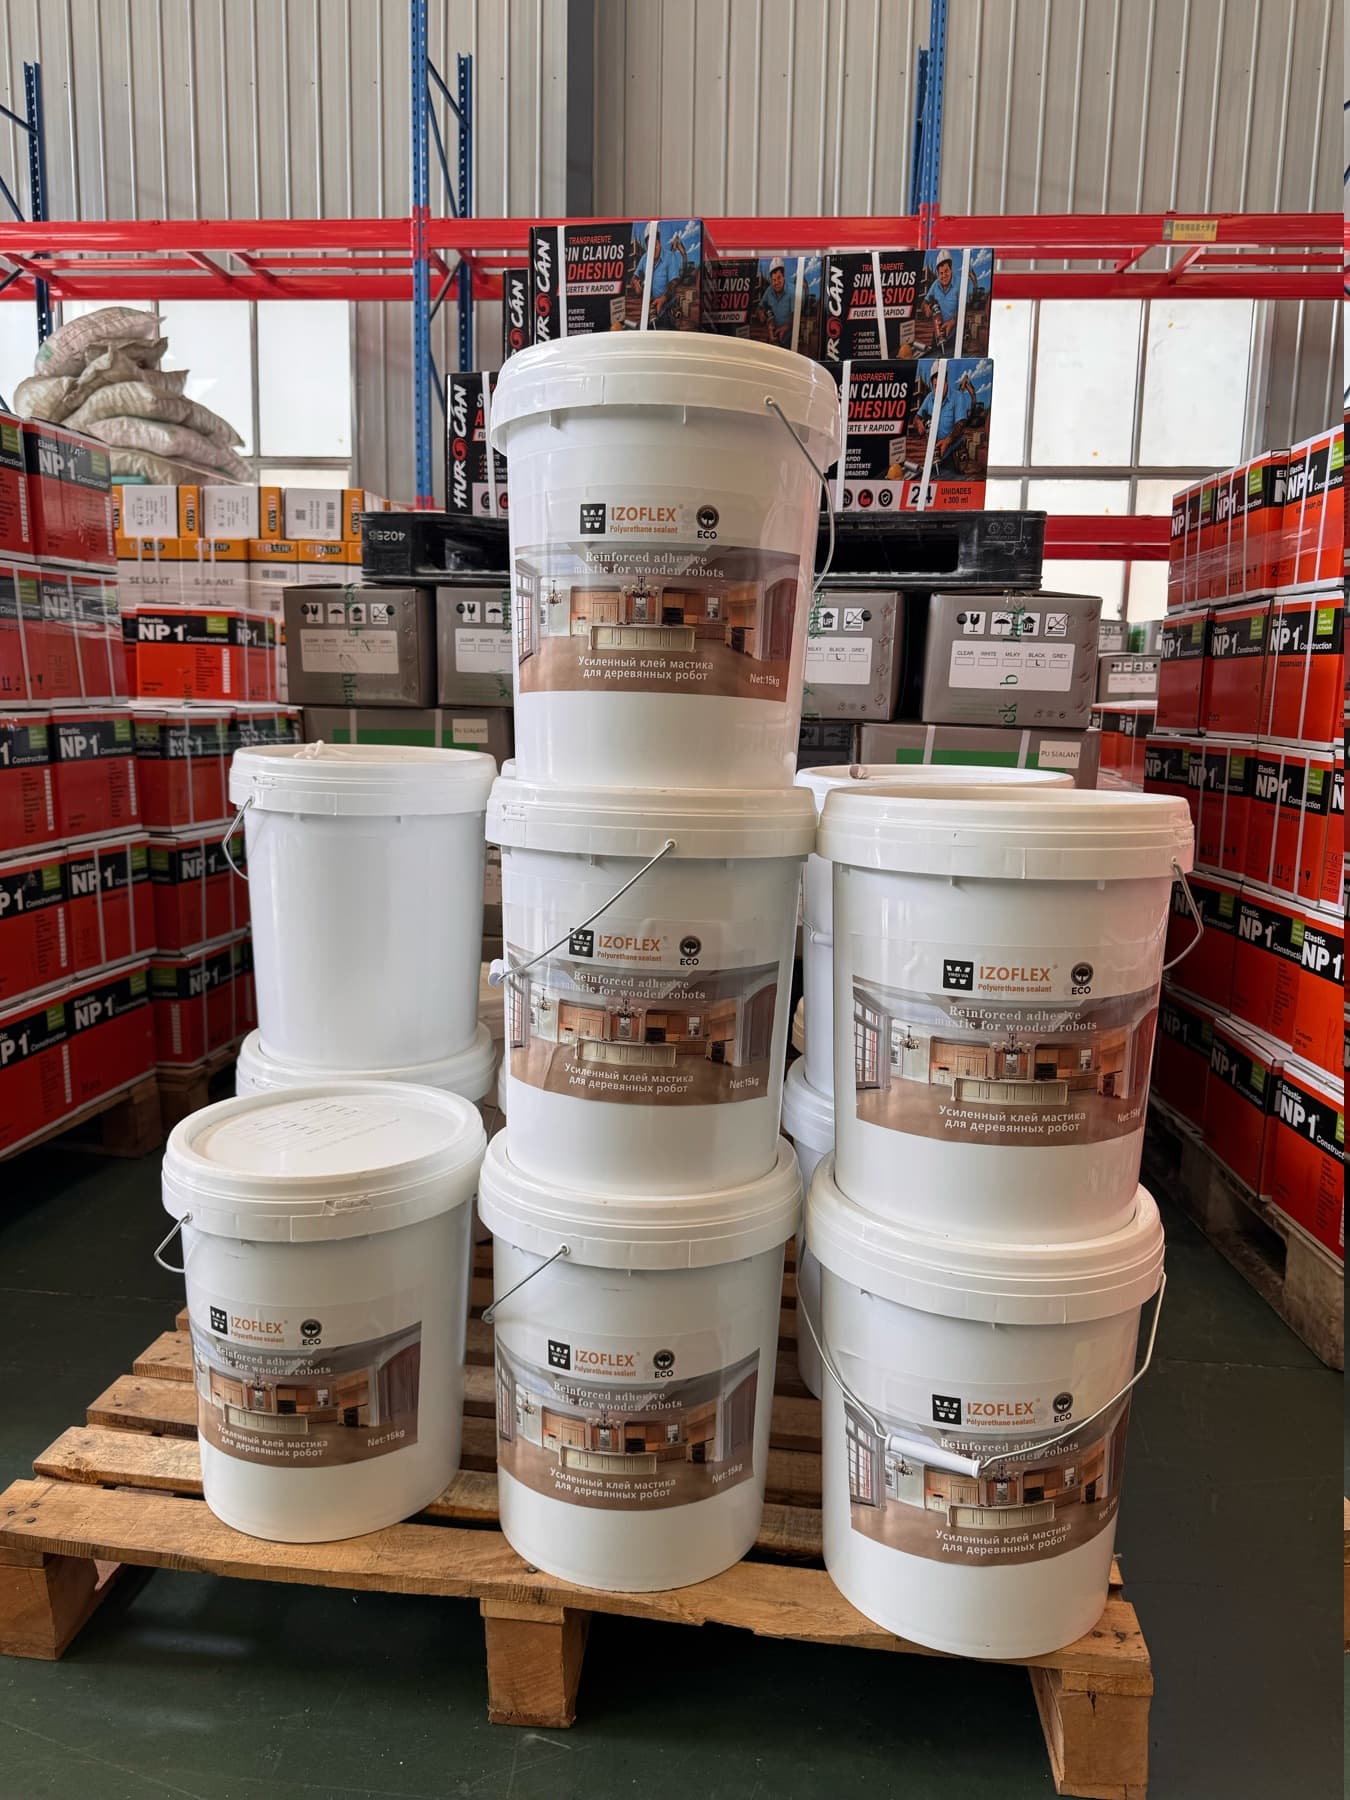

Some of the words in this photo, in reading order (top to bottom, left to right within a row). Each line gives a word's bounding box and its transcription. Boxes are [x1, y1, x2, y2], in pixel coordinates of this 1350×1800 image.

[568, 235, 612, 244] TRANSPARENTE
[583, 244, 624, 261] CLAVOS
[568, 262, 624, 280] DHESIVO
[853, 273, 871, 288] SIN
[880, 272, 916, 286] LAVOS
[591, 284, 614, 293] RAPIDO
[853, 308, 875, 317] FUERTE
[861, 382, 908, 398] CLAVOS
[849, 401, 906, 419] DHESIVO
[863, 424, 868, 432] Y
[869, 424, 894, 432] RAPIDO
[38, 449, 64, 476] NP
[67, 460, 76, 480] 1
[1290, 464, 1304, 474] Elastic
[1287, 475, 1306, 500] NP
[1307, 468, 1314, 492] 1
[610, 506, 676, 522] IZOFLEX
[610, 525, 650, 534] Polyurethane
[652, 526, 678, 534] sealant
[697, 530, 717, 540] ECO
[586, 552, 649, 563] Reinforced
[654, 552, 708, 565] adhesive
[613, 564, 631, 574] for
[634, 564, 684, 576] wooden
[686, 566, 724, 578] robots
[138, 623, 171, 641] NP
[173, 626, 184, 641] 1
[1292, 626, 1300, 650] 1
[1162, 640, 1175, 658] NP
[1213, 634, 1230, 656] NP
[1231, 633, 1237, 654] 1
[578, 656, 636, 668] Усиленный
[640, 657, 666, 668] клей
[670, 660, 713, 670] мастика
[583, 668, 601, 678] для
[604, 668, 672, 680] деревянных
[675, 670, 708, 682] робот
[750, 674, 780, 687] Net:15kg
[60, 736, 87, 758] NP
[90, 736, 98, 755] 1
[12, 755, 48, 764] Construction
[1145, 759, 1162, 778] NP
[1258, 764, 1276, 774] Elastic
[1256, 774, 1278, 799] NP
[72, 870, 101, 895] NP
[104, 867, 113, 887] 1
[14, 888, 23, 910] 1
[1241, 905, 1259, 918] Elastic
[1239, 915, 1262, 941] NP
[1265, 926, 1272, 948] 1
[1304, 931, 1326, 946] Elastic
[598, 935, 660, 952] IZOFLEX
[598, 951, 637, 960] Polyurethane
[680, 958, 699, 966] ECO
[1301, 942, 1330, 972] NP
[1333, 954, 1342, 979] 1
[574, 971, 634, 988] Reinforced
[638, 978, 689, 989] adhesive
[980, 966, 1050, 982] IZOFLEX
[599, 985, 616, 996] for
[620, 987, 665, 999] wooden
[669, 989, 706, 999] robots
[978, 983, 1024, 993] Polyurethane
[1026, 985, 1052, 993] sealant
[1071, 986, 1091, 995] ECO
[74, 1001, 102, 1030] NP
[104, 996, 113, 1016] 1
[950, 1006, 1022, 1020] Reinforced
[1026, 1009, 1081, 1021] adhesive
[981, 1020, 1001, 1031] for
[1005, 1021, 1056, 1032] wooden
[1058, 1020, 1097, 1032] robots
[18, 1033, 28, 1056] 1
[564, 1063, 619, 1081] Усиленный
[623, 1071, 648, 1082] клей
[651, 1074, 694, 1083] мастика
[1211, 1048, 1229, 1075] NP
[1231, 1064, 1236, 1085] 1
[569, 1075, 585, 1085] для
[588, 1076, 653, 1093] деревянных
[656, 1084, 688, 1094] робот
[729, 1077, 759, 1089] Net:15kg
[1282, 1084, 1302, 1103] Elastic
[939, 1105, 1006, 1122] Усиленный
[1010, 1110, 1038, 1122] клей
[1042, 1111, 1086, 1122] мастика
[1280, 1095, 1306, 1128] NP
[1308, 1114, 1316, 1139] 1
[945, 1119, 966, 1130] для
[969, 1122, 1044, 1134] деревянных
[1047, 1122, 1080, 1134] робот
[231, 1316, 282, 1334] IZOFLEX
[302, 1338, 321, 1346] ECO
[216, 1344, 264, 1365] Reinforced
[266, 1357, 314, 1366] adhesive
[575, 1350, 634, 1367] IZOFLEX
[235, 1362, 249, 1372] for
[252, 1365, 292, 1375] wooden
[295, 1366, 332, 1376] robots
[574, 1365, 612, 1376] Polyurethane
[654, 1370, 674, 1379] ECO
[554, 1381, 611, 1400] Reinforced
[614, 1391, 665, 1401] adhesive
[578, 1398, 594, 1409] for
[598, 1400, 642, 1412] wooden
[644, 1399, 683, 1412] robots
[967, 1402, 1033, 1416] IZOFLEX
[966, 1418, 1010, 1426] Polyurethane
[1012, 1418, 1036, 1426] sealant
[1054, 1413, 1072, 1424] ECO
[217, 1423, 259, 1445] Усиленный
[262, 1438, 284, 1448] клей
[287, 1439, 328, 1449] мастика
[367, 1429, 405, 1448] Net:15kg
[221, 1436, 235, 1447] для
[235, 1441, 290, 1457] деревянных
[292, 1448, 322, 1459] робот
[940, 1438, 1009, 1453] Reinforced
[1043, 1443, 1080, 1459] robots
[550, 1467, 603, 1488] Усиленный
[606, 1479, 631, 1490] клей
[634, 1479, 676, 1490] мастика
[555, 1480, 571, 1492] для
[574, 1485, 637, 1499] деревянных
[640, 1488, 671, 1500] робот
[936, 1530, 999, 1545] Усиленный
[1003, 1532, 1029, 1545] клей
[1032, 1523, 1072, 1540] мастика
[942, 1542, 962, 1554] для
[966, 1542, 1035, 1556] деревянных
[1038, 1534, 1066, 1551] робот
